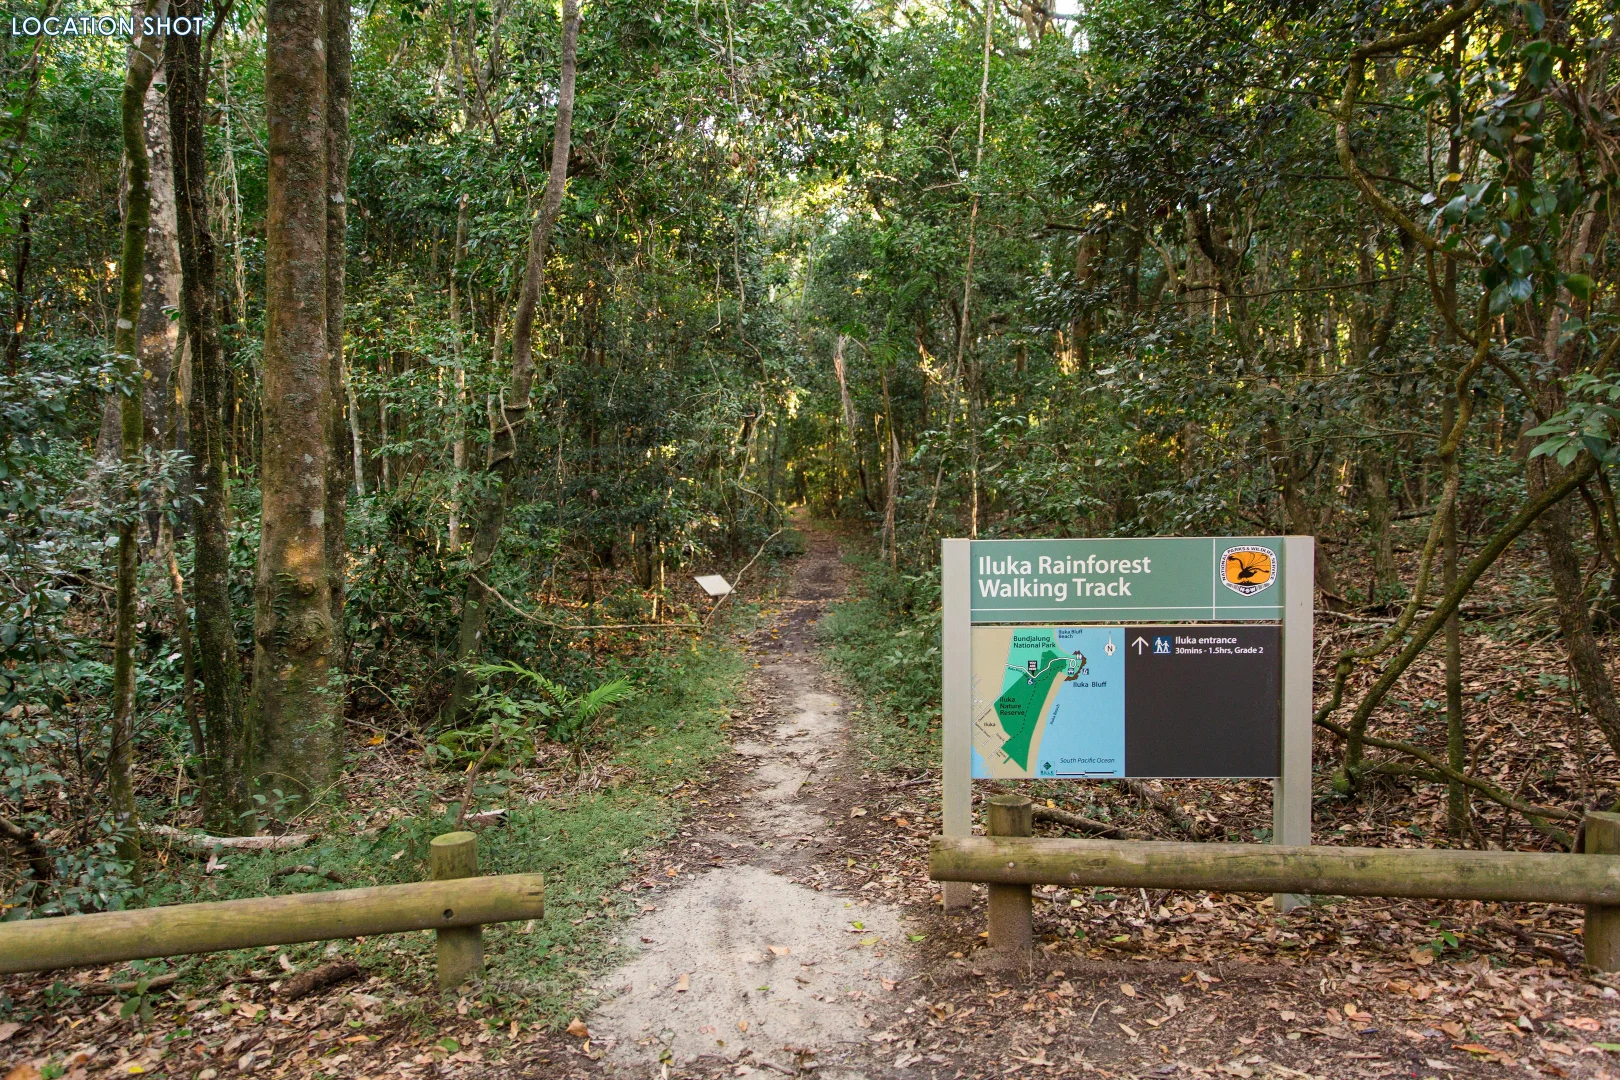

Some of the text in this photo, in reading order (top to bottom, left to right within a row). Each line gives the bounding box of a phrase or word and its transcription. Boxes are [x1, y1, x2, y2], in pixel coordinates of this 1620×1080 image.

[1227, 546, 1246, 554] PARKS
[1251, 547, 1273, 556] WILDLIFE
[978, 555, 1151, 575] Iluka Rainforest
[978, 577, 1132, 602] Walking Track
[1013, 635, 1051, 643] Bundjalung
[1175, 636, 1237, 645] Iluka entrance
[1208, 646, 1233, 655] 1.5hrs,
[1235, 646, 1257, 654] Grade
